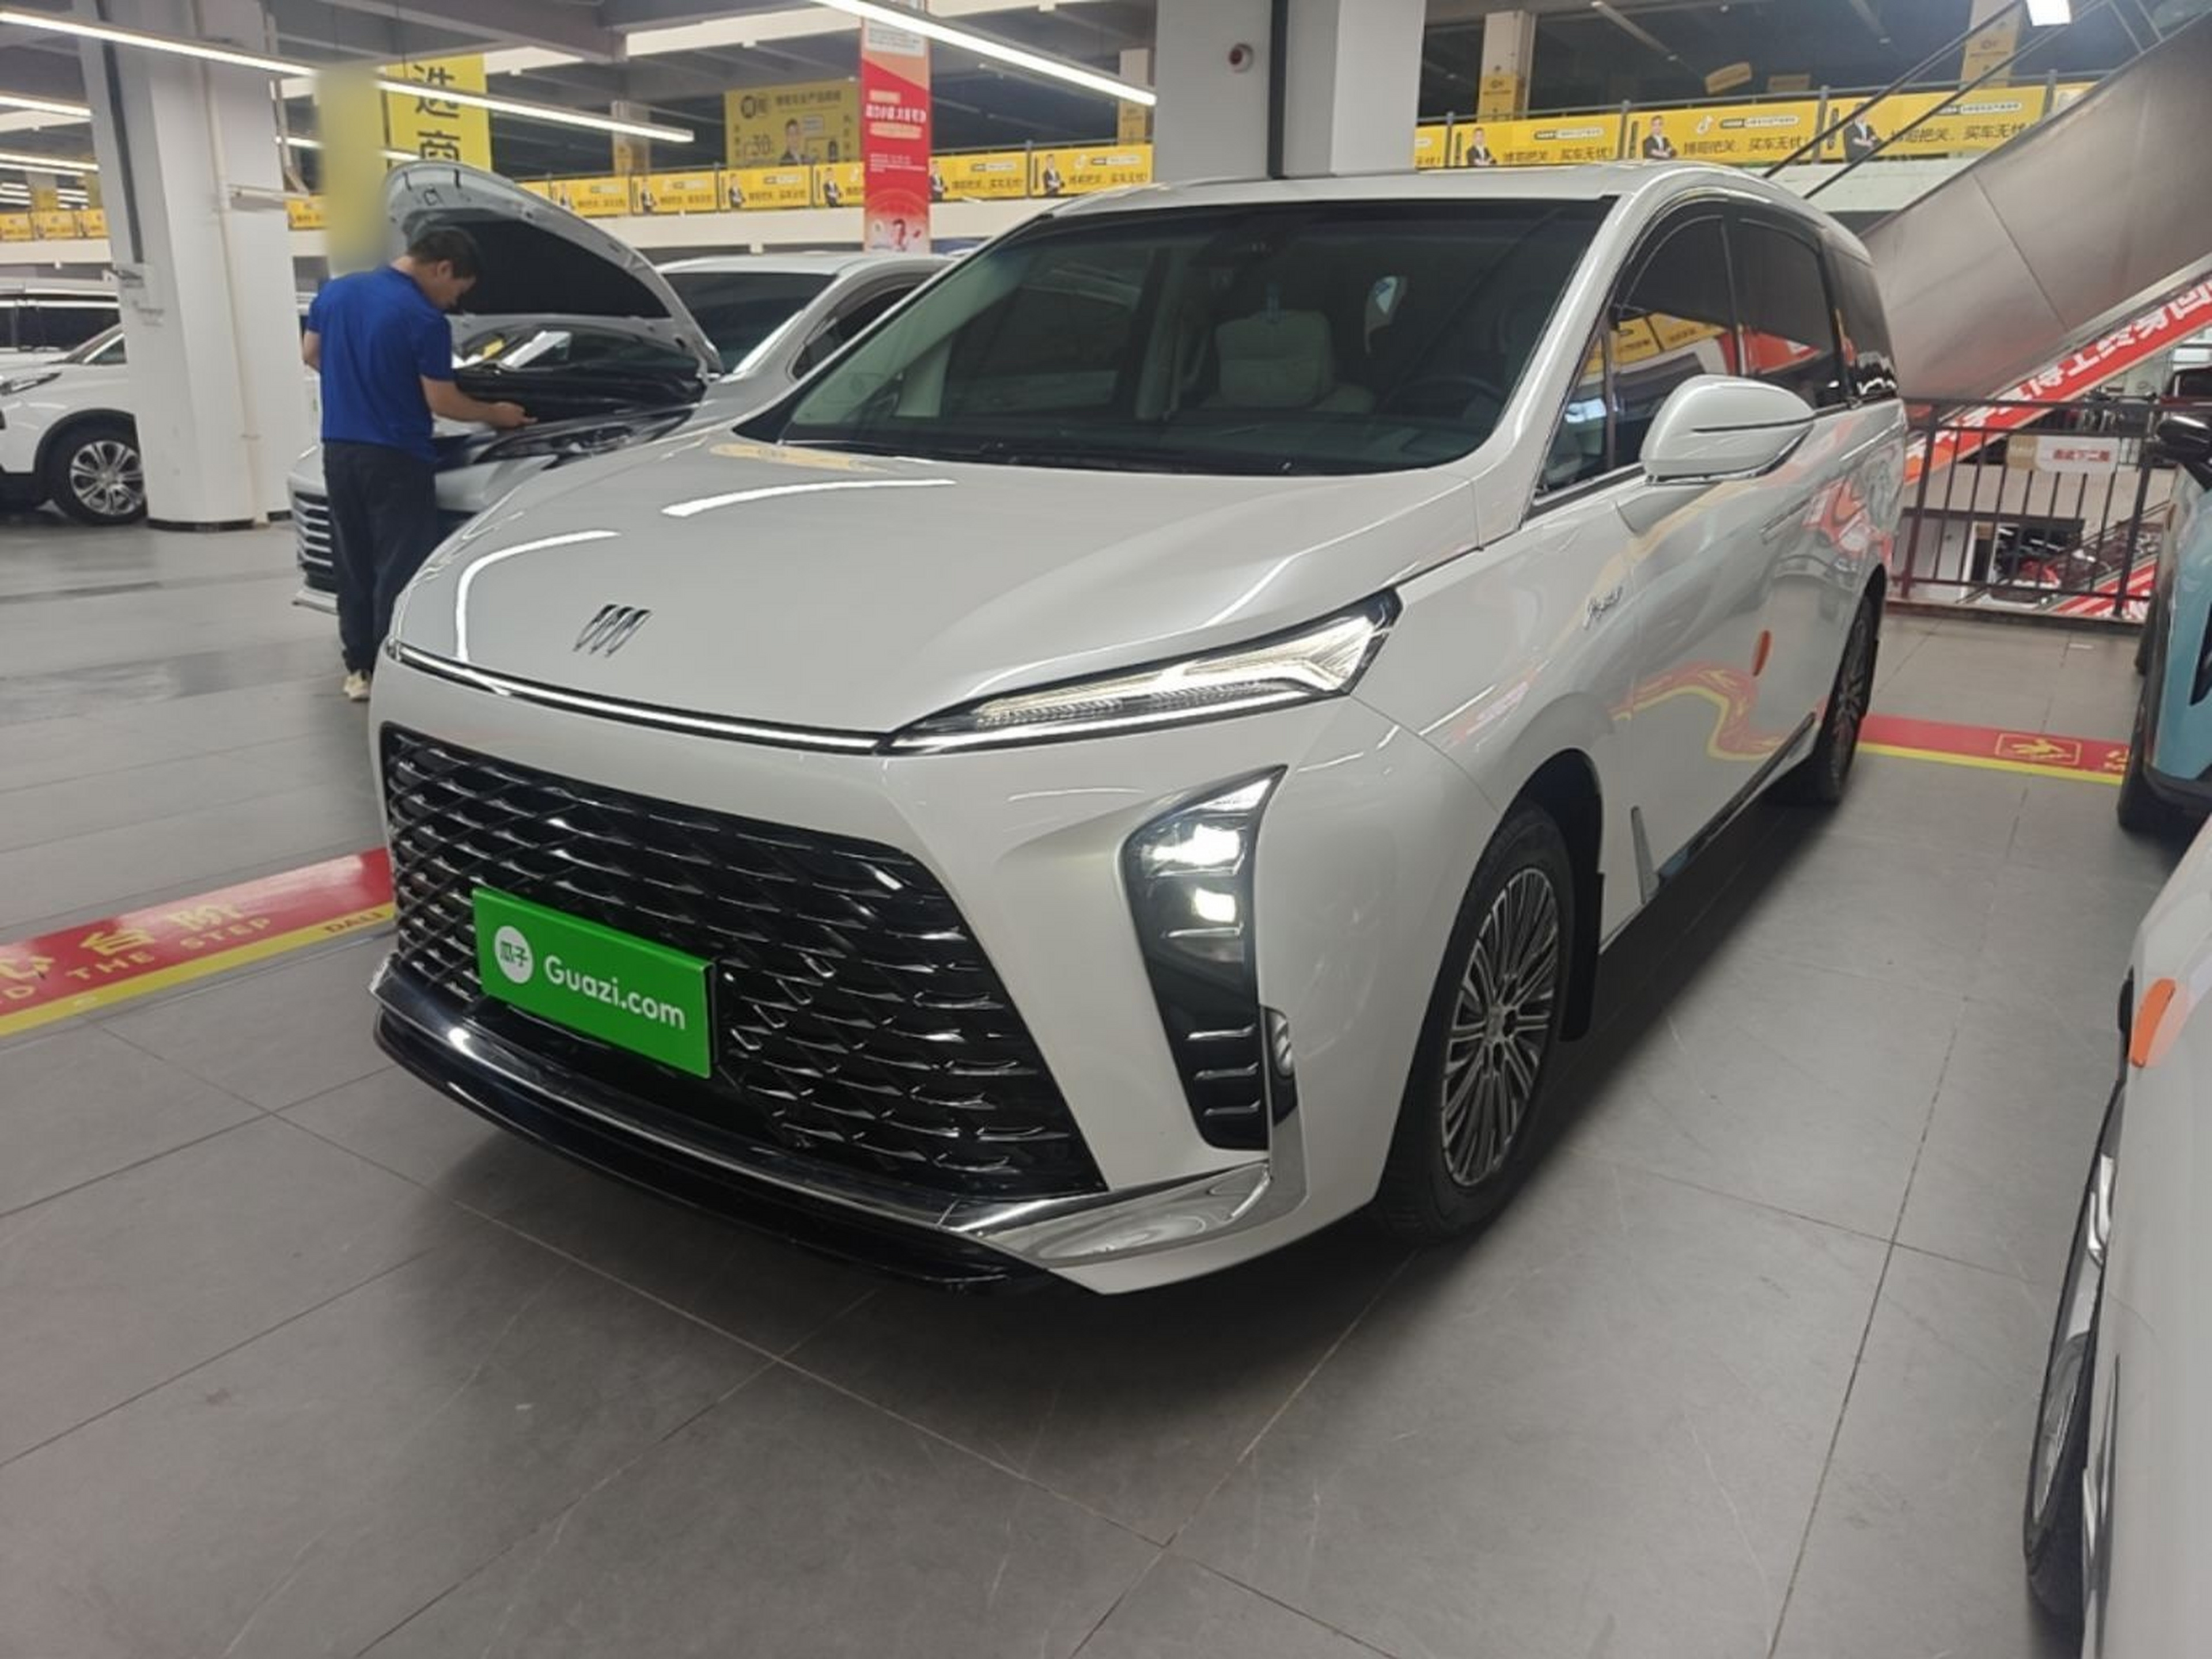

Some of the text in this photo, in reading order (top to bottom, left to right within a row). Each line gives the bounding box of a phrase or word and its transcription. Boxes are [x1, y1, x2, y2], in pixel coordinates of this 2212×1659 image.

[0, 917, 271, 1001] D THE STEP
[499, 940, 529, 968] 瓜子
[544, 954, 686, 1030] Guazi.com
